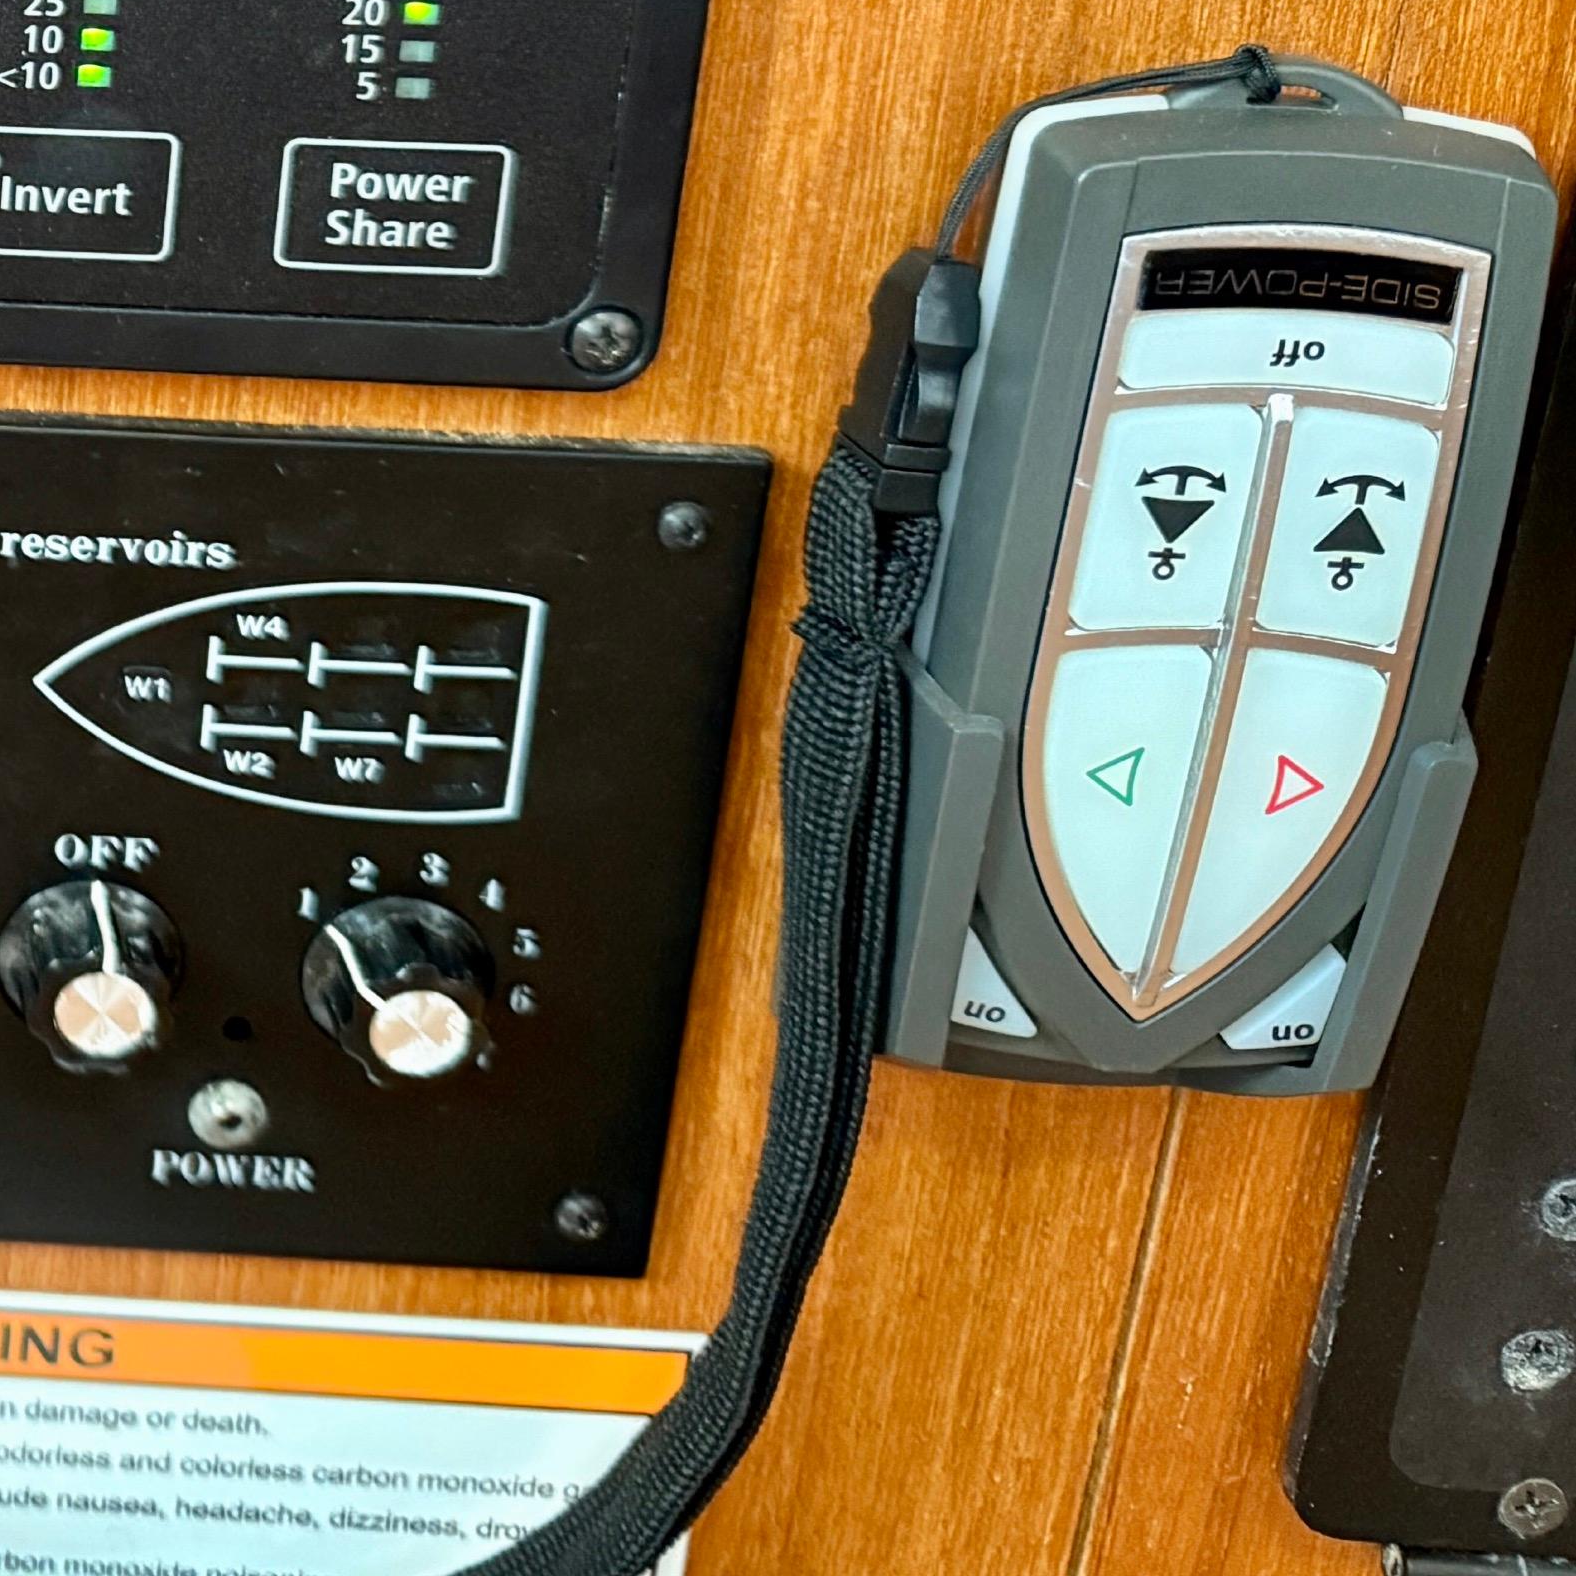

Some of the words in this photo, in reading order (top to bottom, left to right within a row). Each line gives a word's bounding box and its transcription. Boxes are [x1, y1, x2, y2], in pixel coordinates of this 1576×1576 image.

[24, 25, 64, 54] 10
[341, 35, 383, 64] 15
[355, 72, 380, 101] 5
[0, 174, 134, 218] Invert
[329, 161, 474, 204] Power
[324, 208, 457, 251] Share
[1155, 269, 1441, 310] SIDE-POWER
[1269, 339, 1326, 367] off
[0, 526, 239, 571] reservoirs
[236, 614, 291, 641] W4
[123, 675, 172, 702] W1
[223, 749, 277, 780] W2
[54, 834, 160, 873] OFF
[419, 852, 450, 887] 3
[349, 856, 381, 893] 2
[298, 886, 320, 922] 1
[480, 878, 507, 912] 4
[513, 927, 542, 960] 5
[509, 983, 538, 1016] 6
[963, 1000, 1006, 1024] on
[1271, 1023, 1314, 1042] on
[151, 1149, 317, 1192] POWER
[25, 1398, 136, 1429] damage
[146, 1410, 175, 1428] or
[182, 1409, 270, 1437] death.
